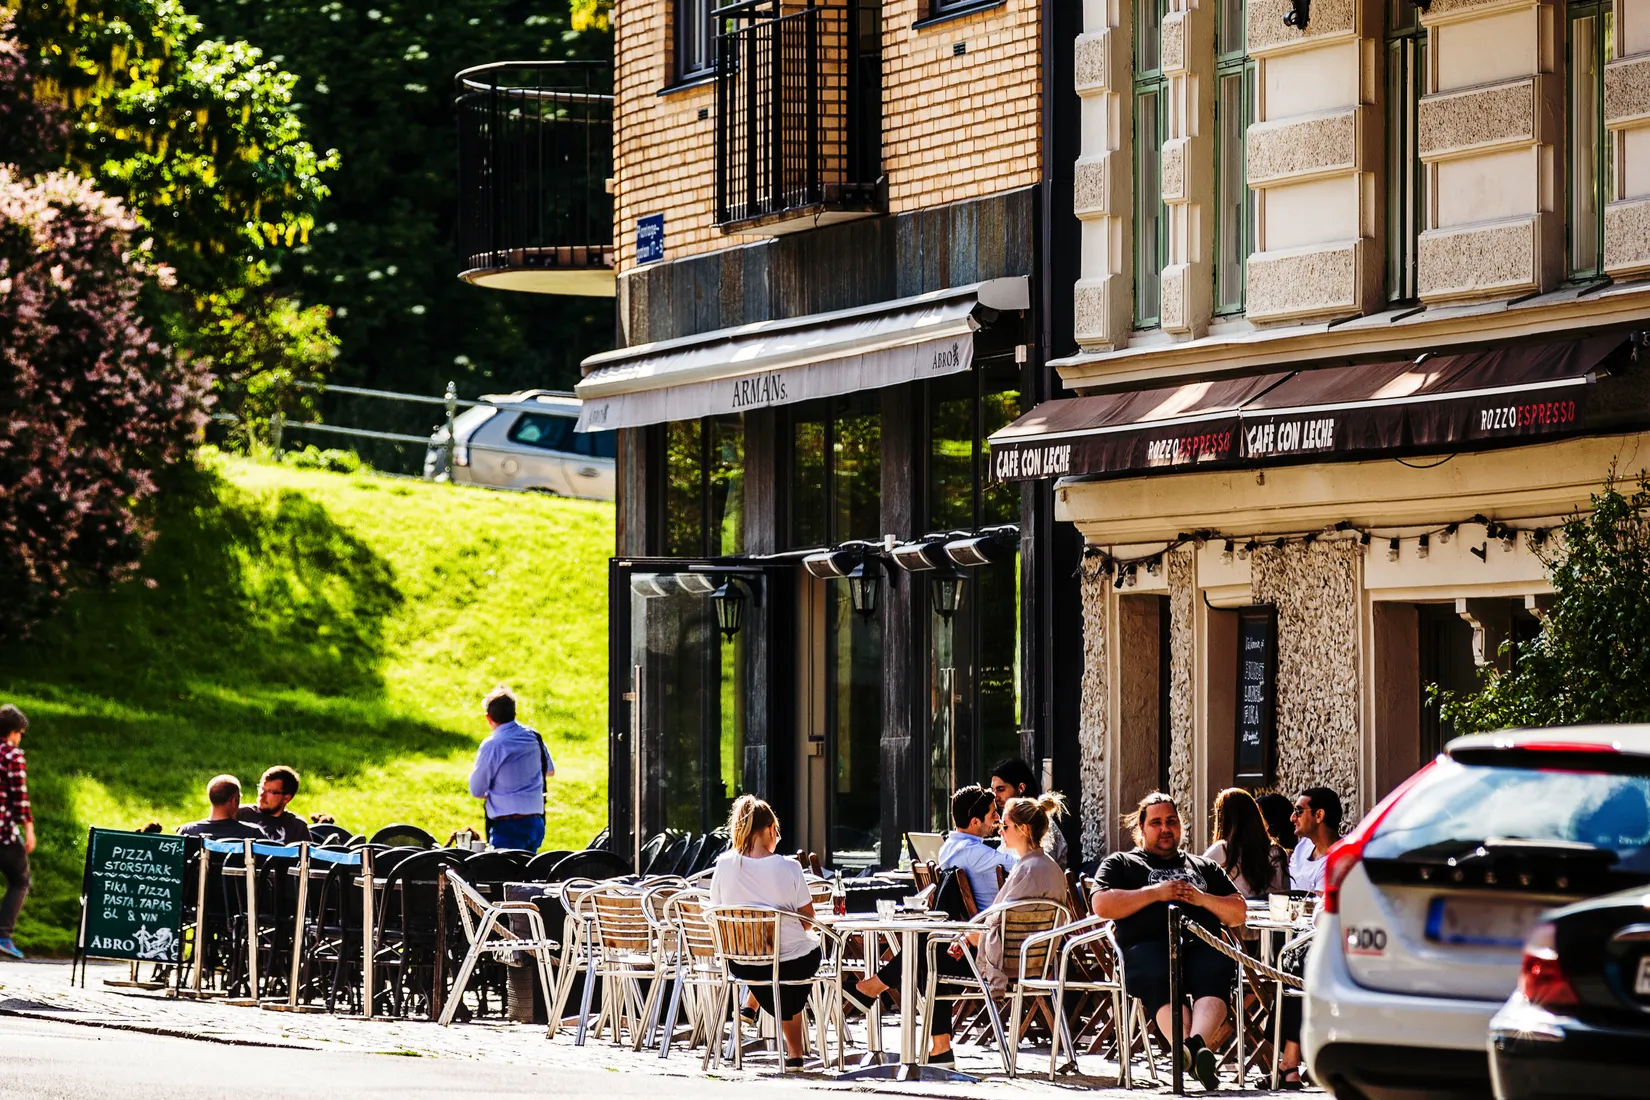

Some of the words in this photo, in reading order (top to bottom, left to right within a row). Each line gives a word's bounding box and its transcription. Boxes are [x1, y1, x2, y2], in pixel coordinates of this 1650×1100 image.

[1247, 416, 1275, 453] CAFÉ
[1277, 421, 1301, 452] CON
[1302, 418, 1335, 449] LECHE
[996, 443, 1019, 479] CAFÉ
[1021, 448, 1042, 477] CON
[1043, 444, 1071, 474] LECHE
[112, 846, 153, 861] PIZZA
[104, 861, 172, 876] STORSTARK
[104, 880, 127, 894] FIKA
[137, 884, 171, 898] PIZZA
[139, 898, 172, 911] TAPAS
[103, 907, 119, 919] ÖL
[127, 909, 136, 922] &
[140, 912, 158, 922] VIN
